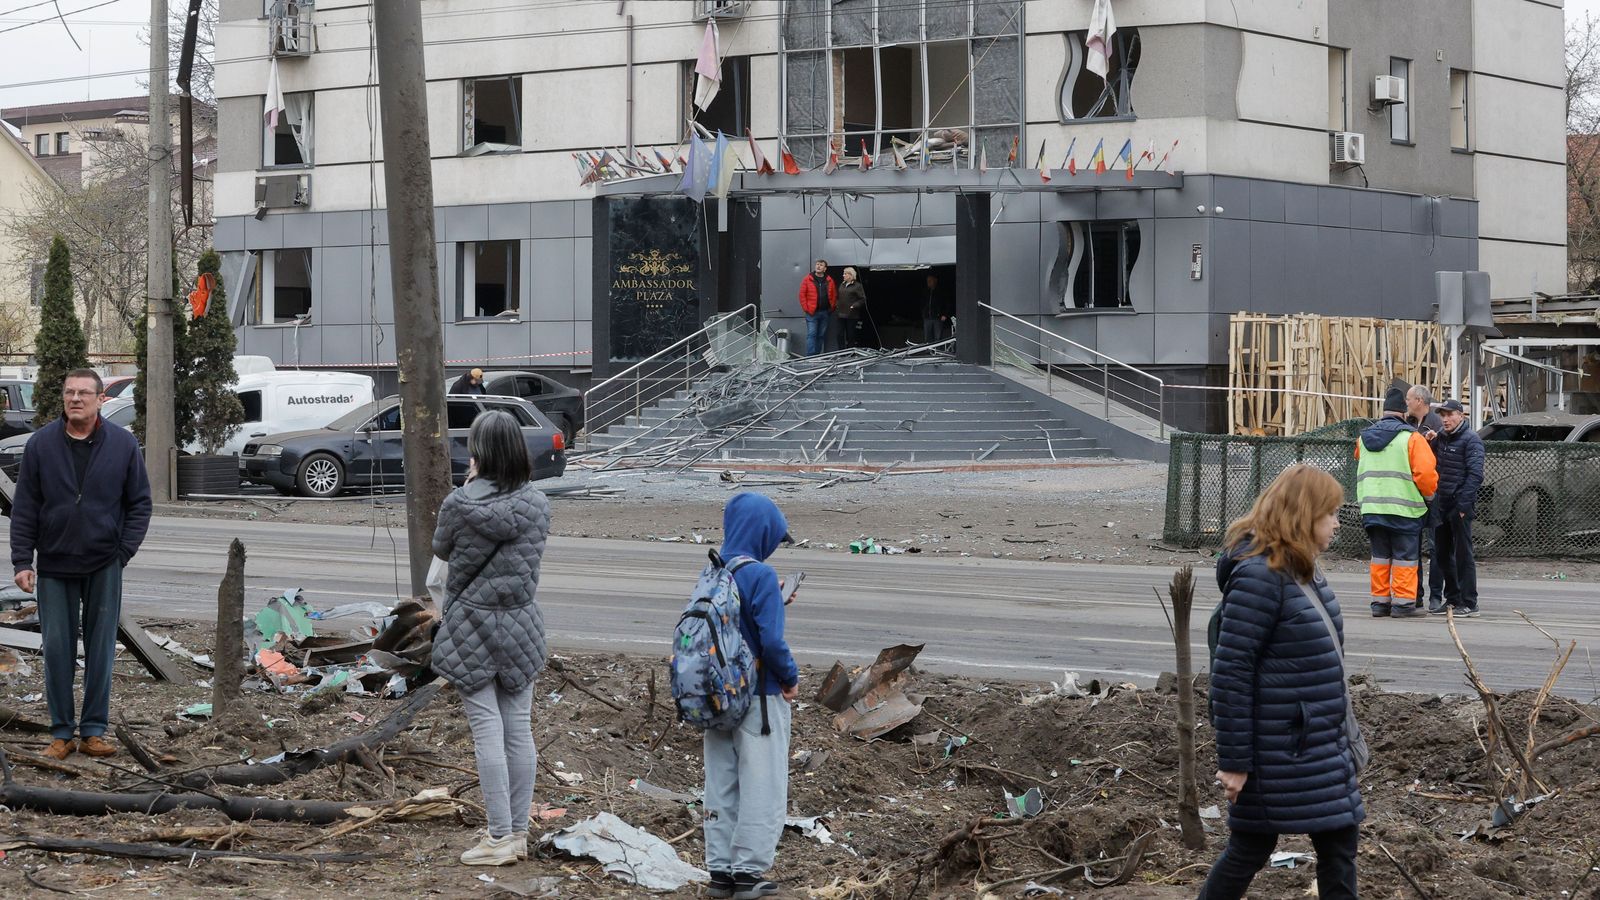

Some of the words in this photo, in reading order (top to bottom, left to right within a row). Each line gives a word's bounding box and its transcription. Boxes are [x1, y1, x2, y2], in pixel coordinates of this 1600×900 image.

[612, 279, 697, 290] AMBASSADOR
[636, 291, 673, 301] PLAZA
[287, 394, 350, 405] Autostrada
